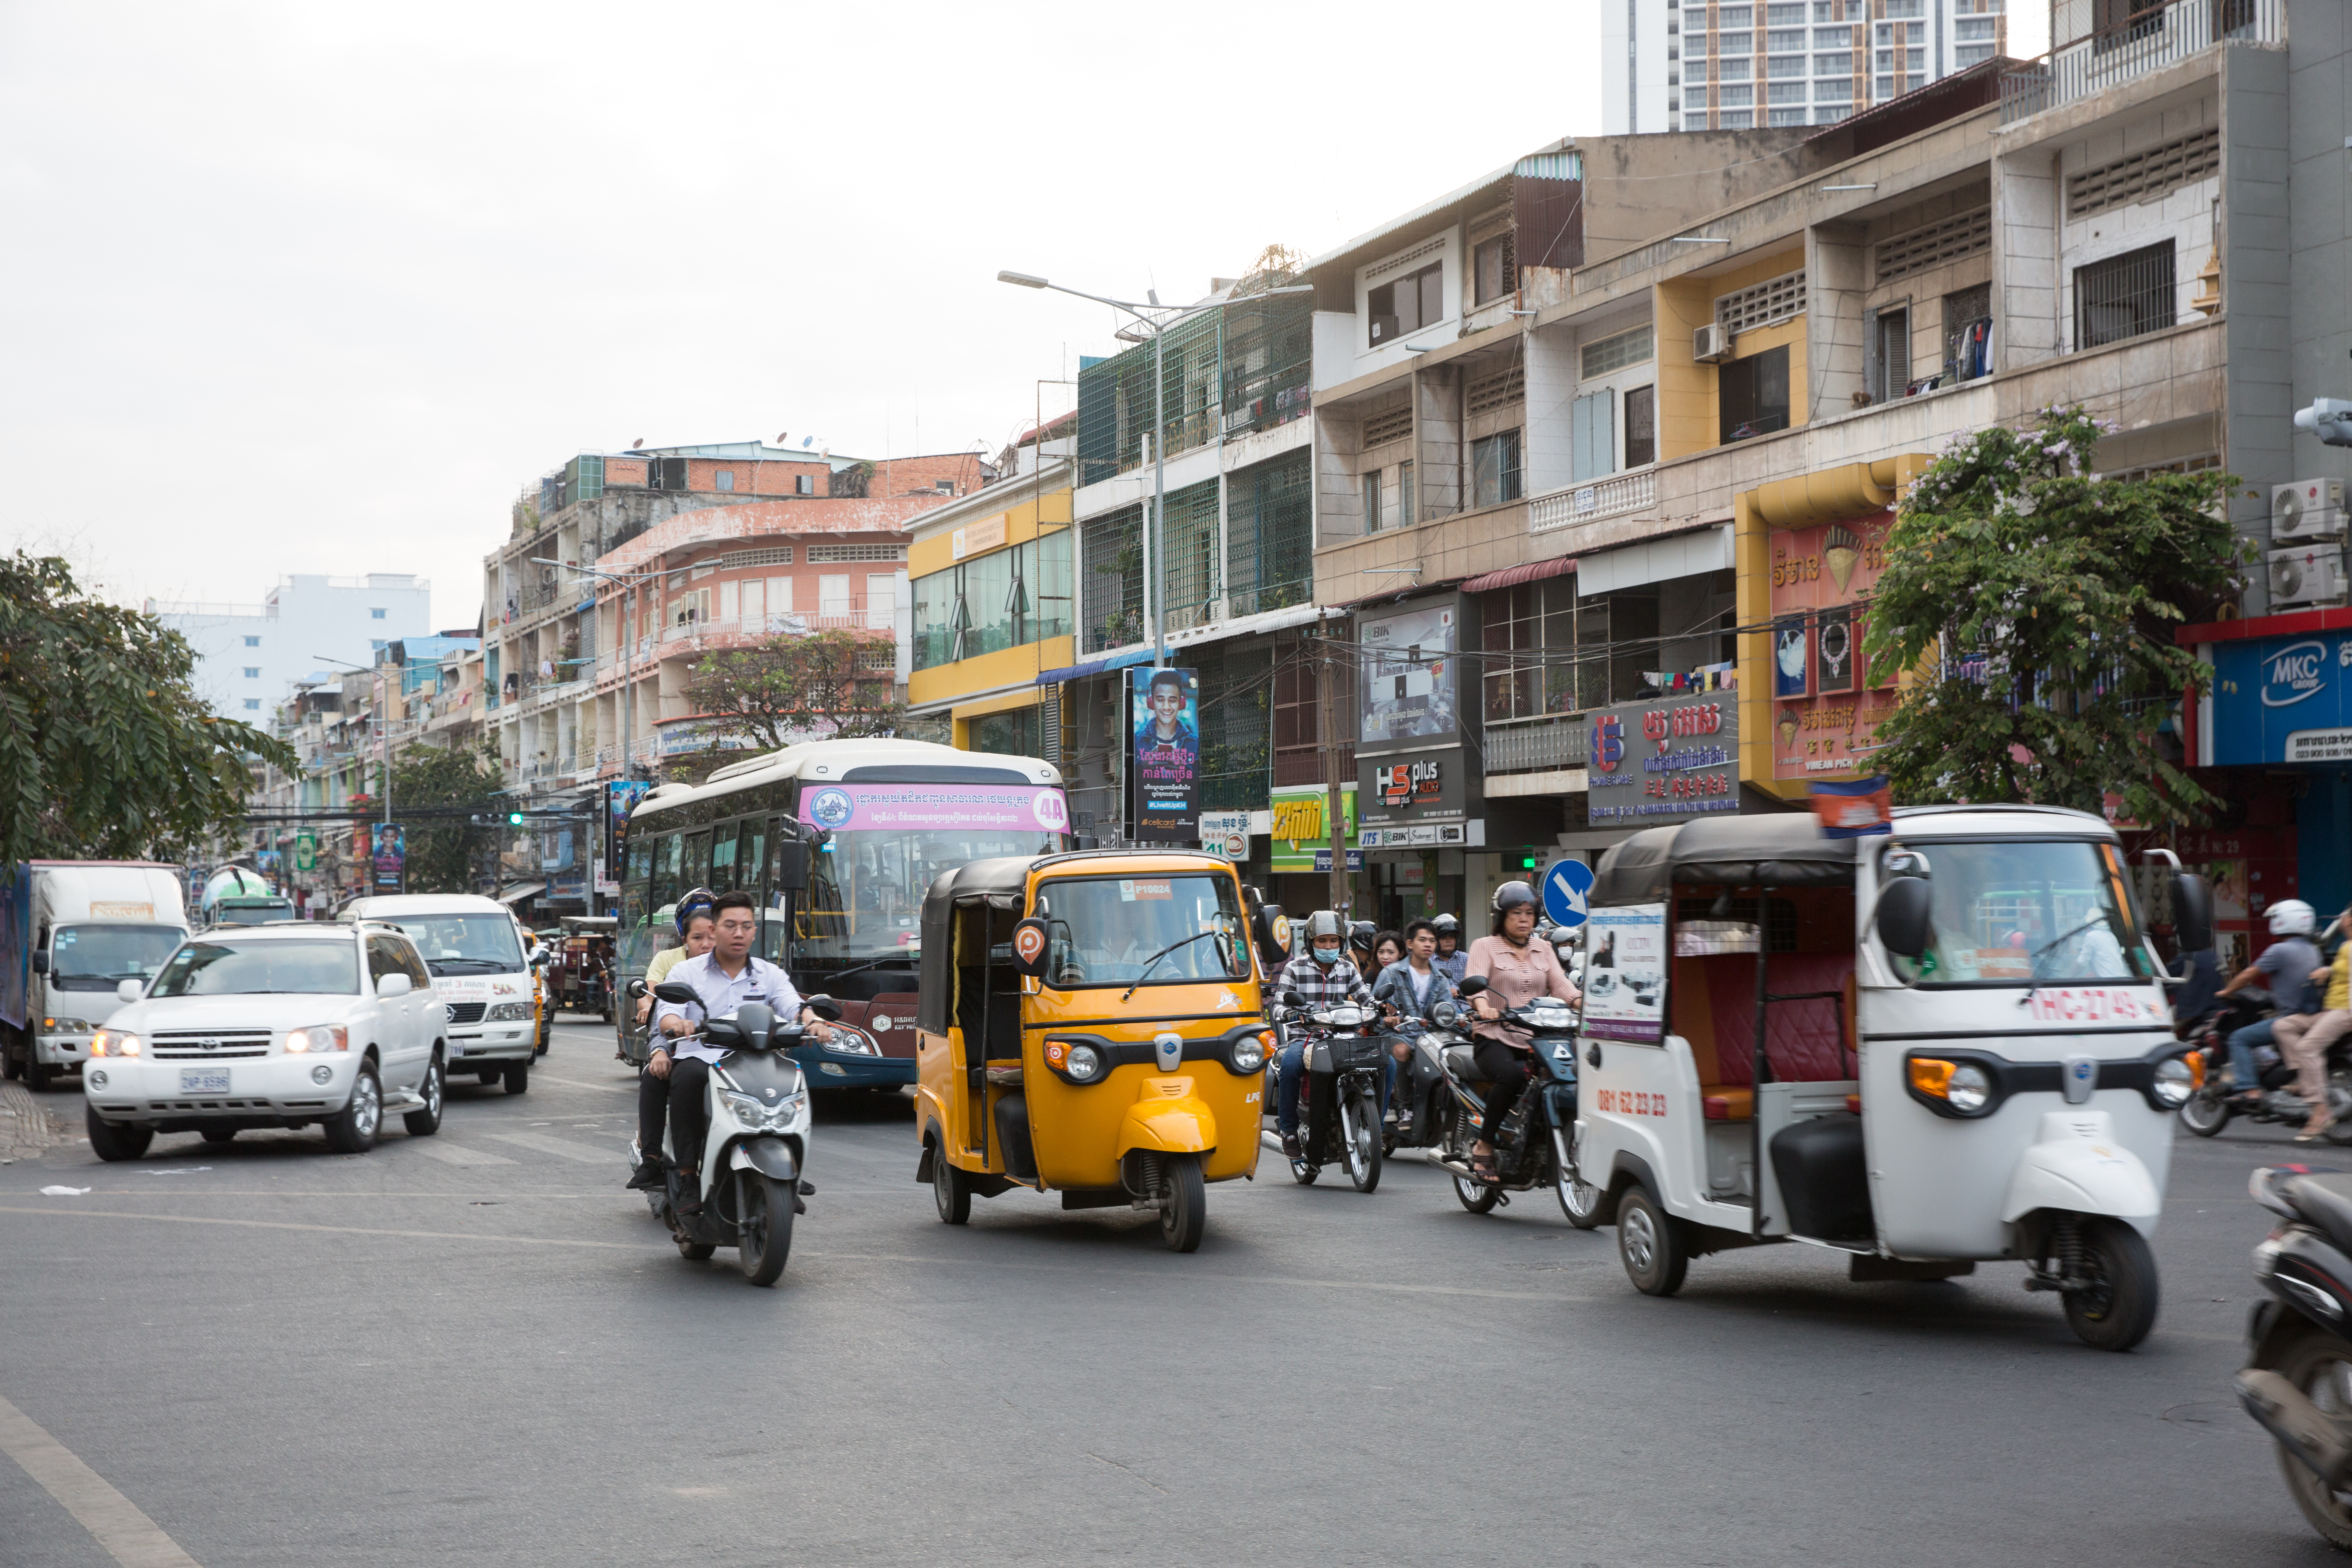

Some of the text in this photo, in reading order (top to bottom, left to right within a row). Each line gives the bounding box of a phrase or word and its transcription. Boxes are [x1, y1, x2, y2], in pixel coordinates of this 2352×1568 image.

[2272, 653, 2319, 684] MKC
[2292, 678, 2320, 690] GROUP
[1805, 760, 1833, 771] VIMEAN
[1143, 766, 1193, 783] កាន់តែច្រើន
[1376, 760, 1437, 796] HS plus
[1419, 781, 1439, 793] AUDIO
[1040, 797, 1064, 821] 4A
[1362, 832, 1377, 845] JTS
[1392, 832, 1408, 841] BIK
[1135, 884, 1171, 894] P10024
[1597, 1089, 1668, 1118] 081 62 23 23
